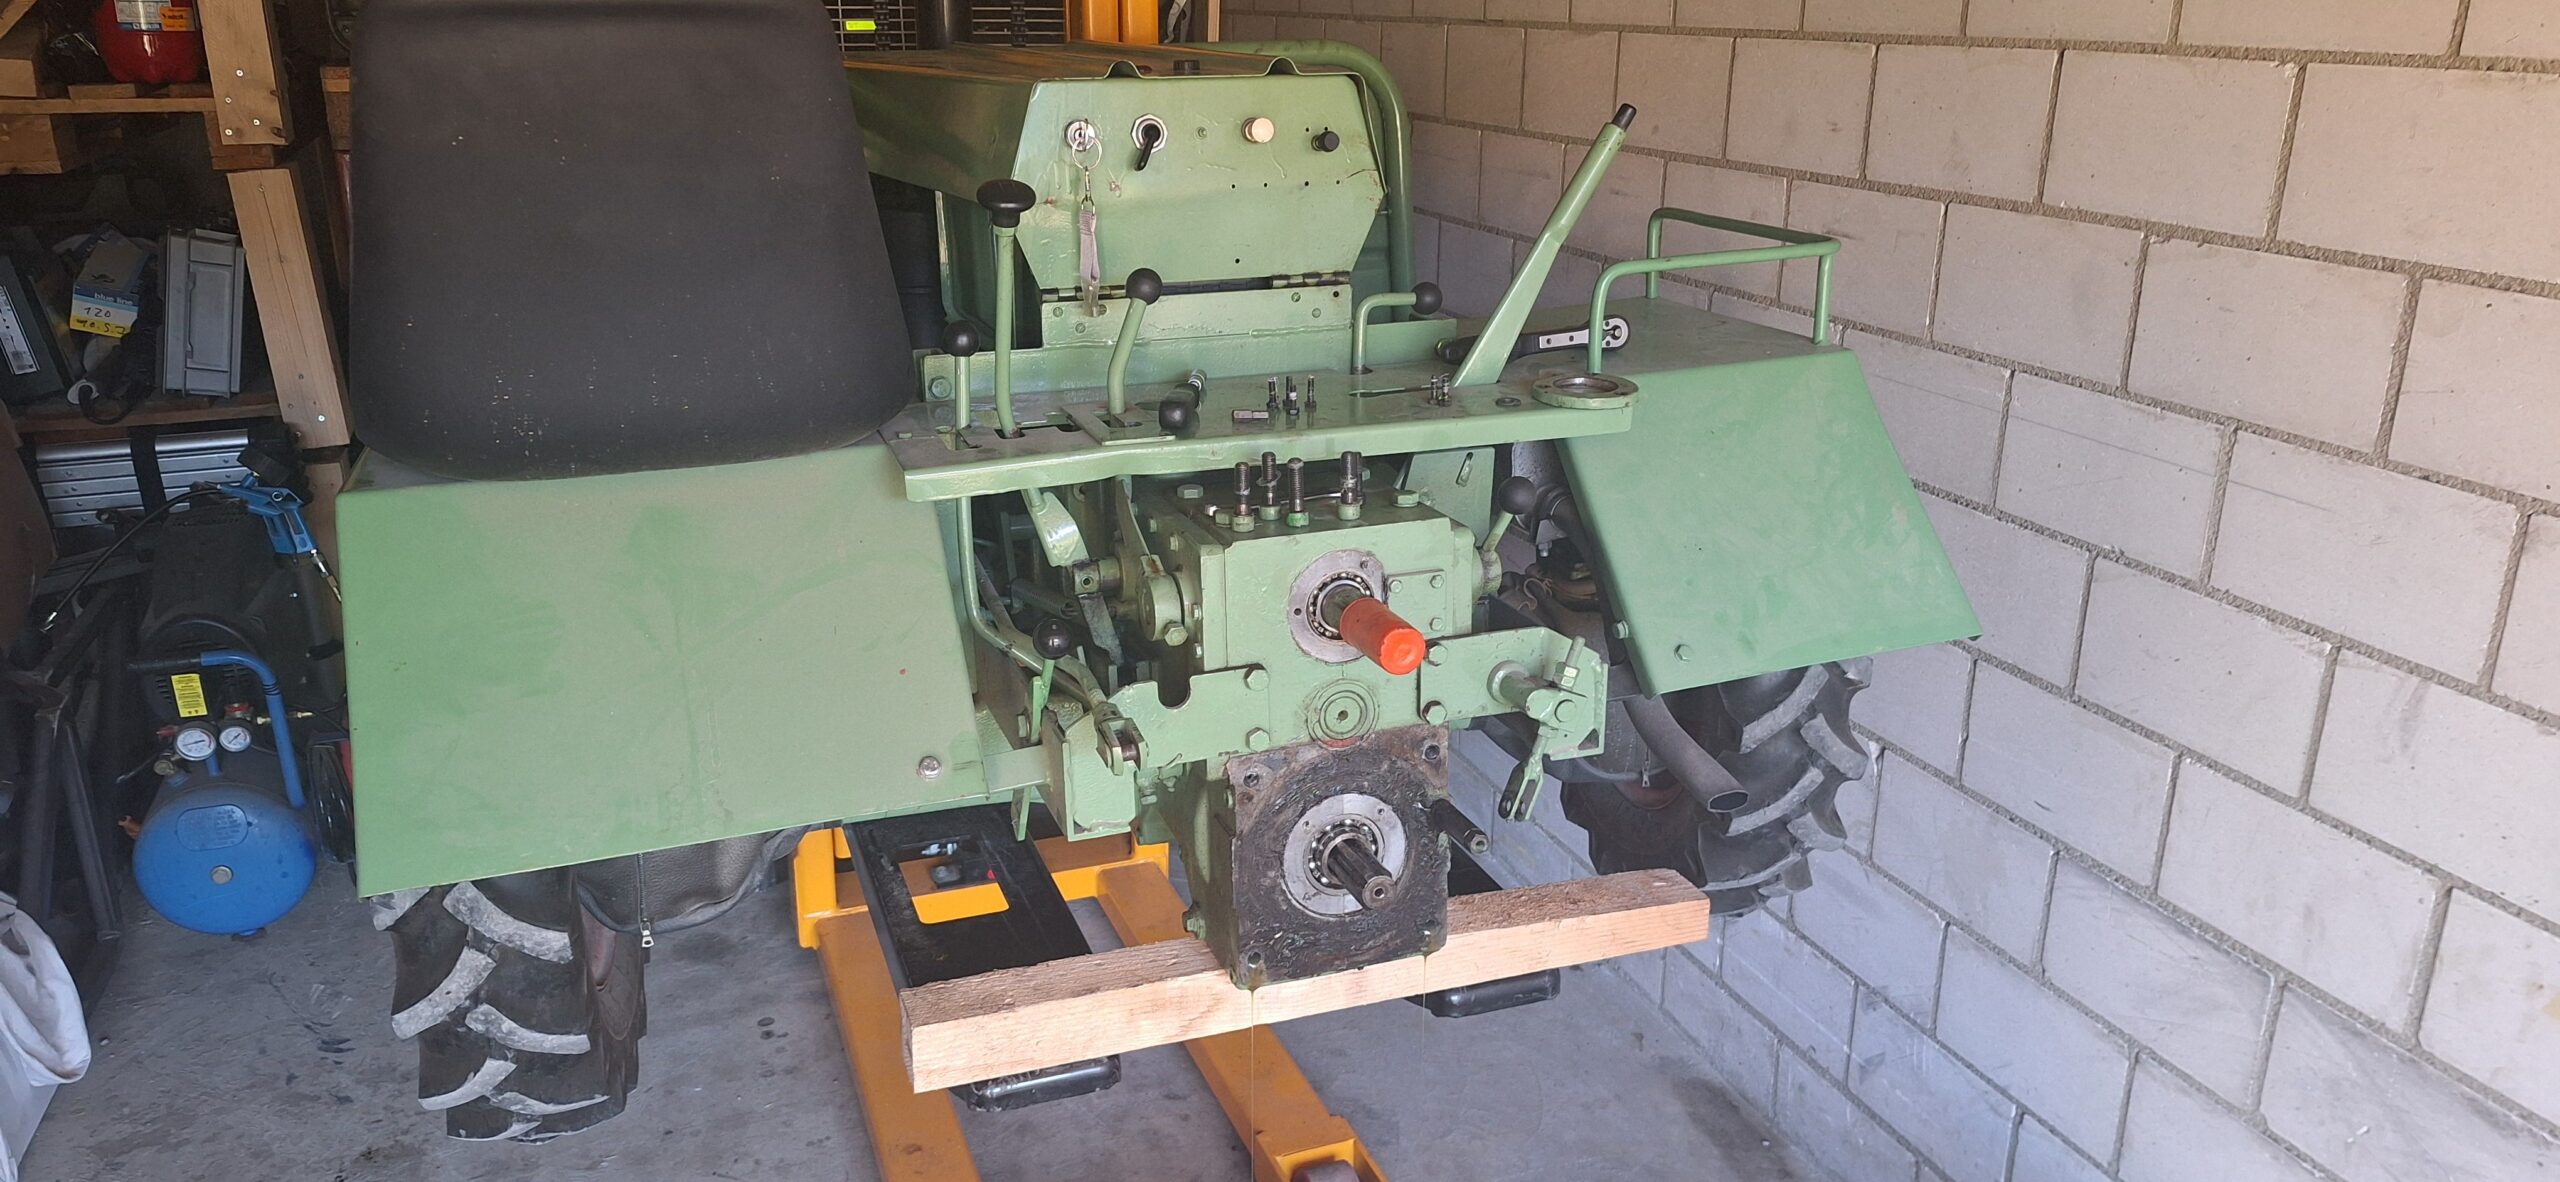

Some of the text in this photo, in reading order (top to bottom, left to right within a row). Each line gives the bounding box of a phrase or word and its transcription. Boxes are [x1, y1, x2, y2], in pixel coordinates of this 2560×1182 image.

[94, 291, 134, 306] blue line
[83, 306, 112, 318] 120
